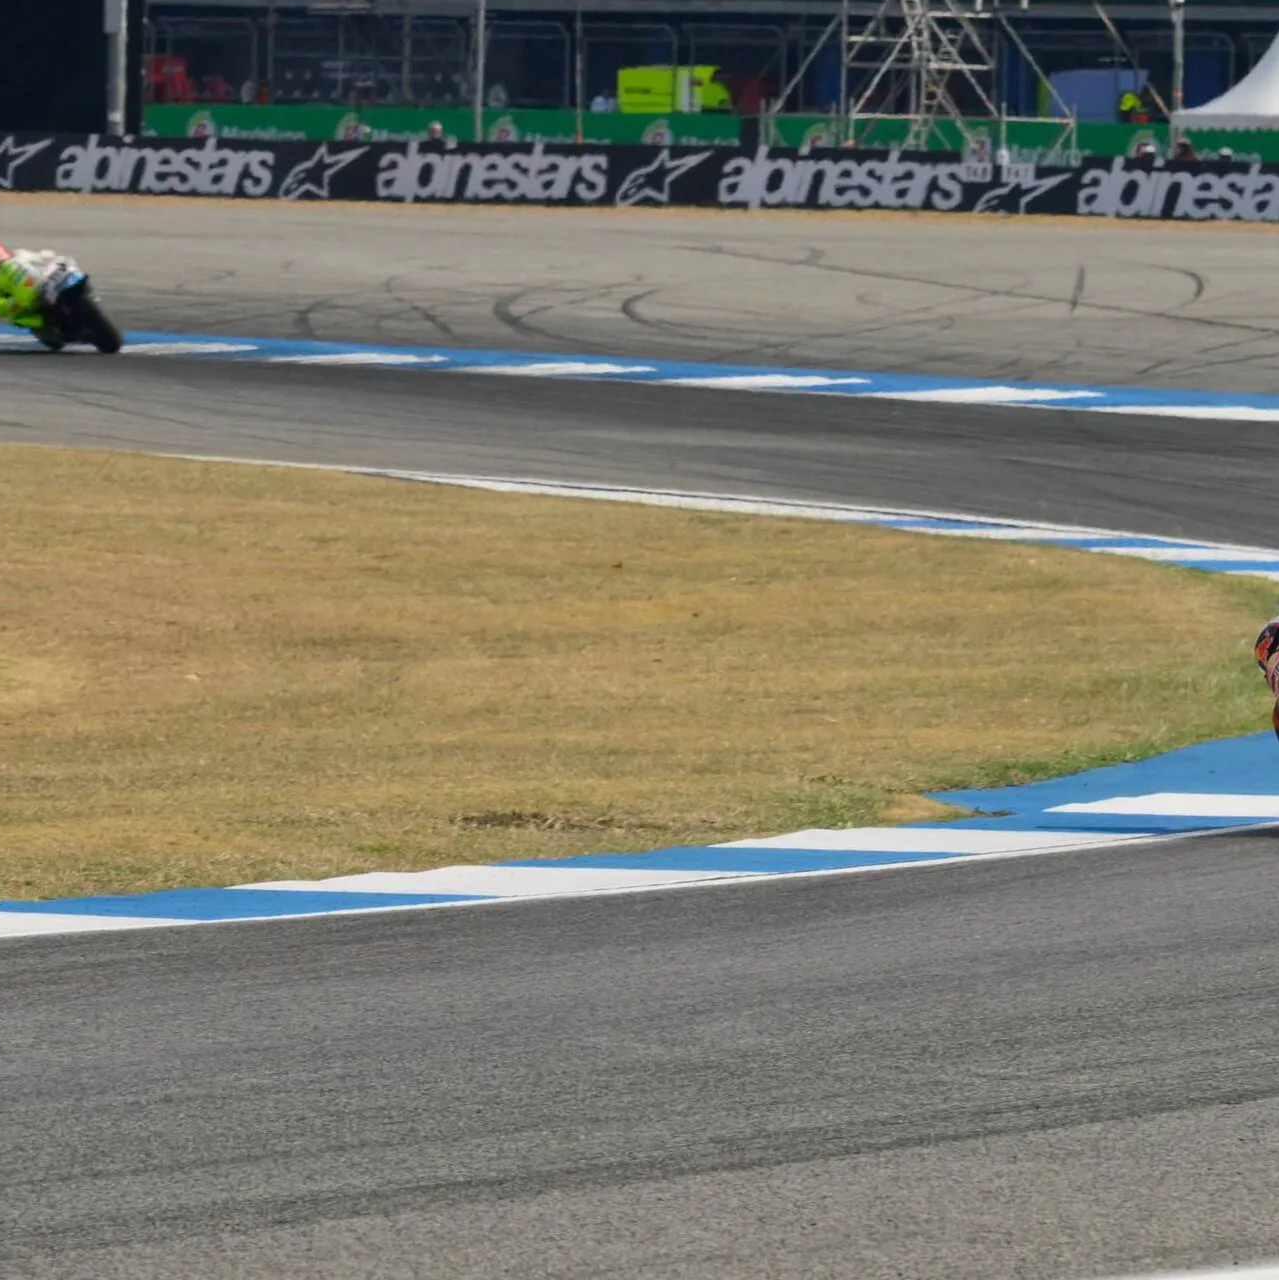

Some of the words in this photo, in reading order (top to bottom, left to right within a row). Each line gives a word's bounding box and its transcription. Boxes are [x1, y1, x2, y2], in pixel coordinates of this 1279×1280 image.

[55, 134, 276, 194] alpinestars
[375, 139, 609, 204] alpinestars
[717, 144, 964, 211] alpinestars
